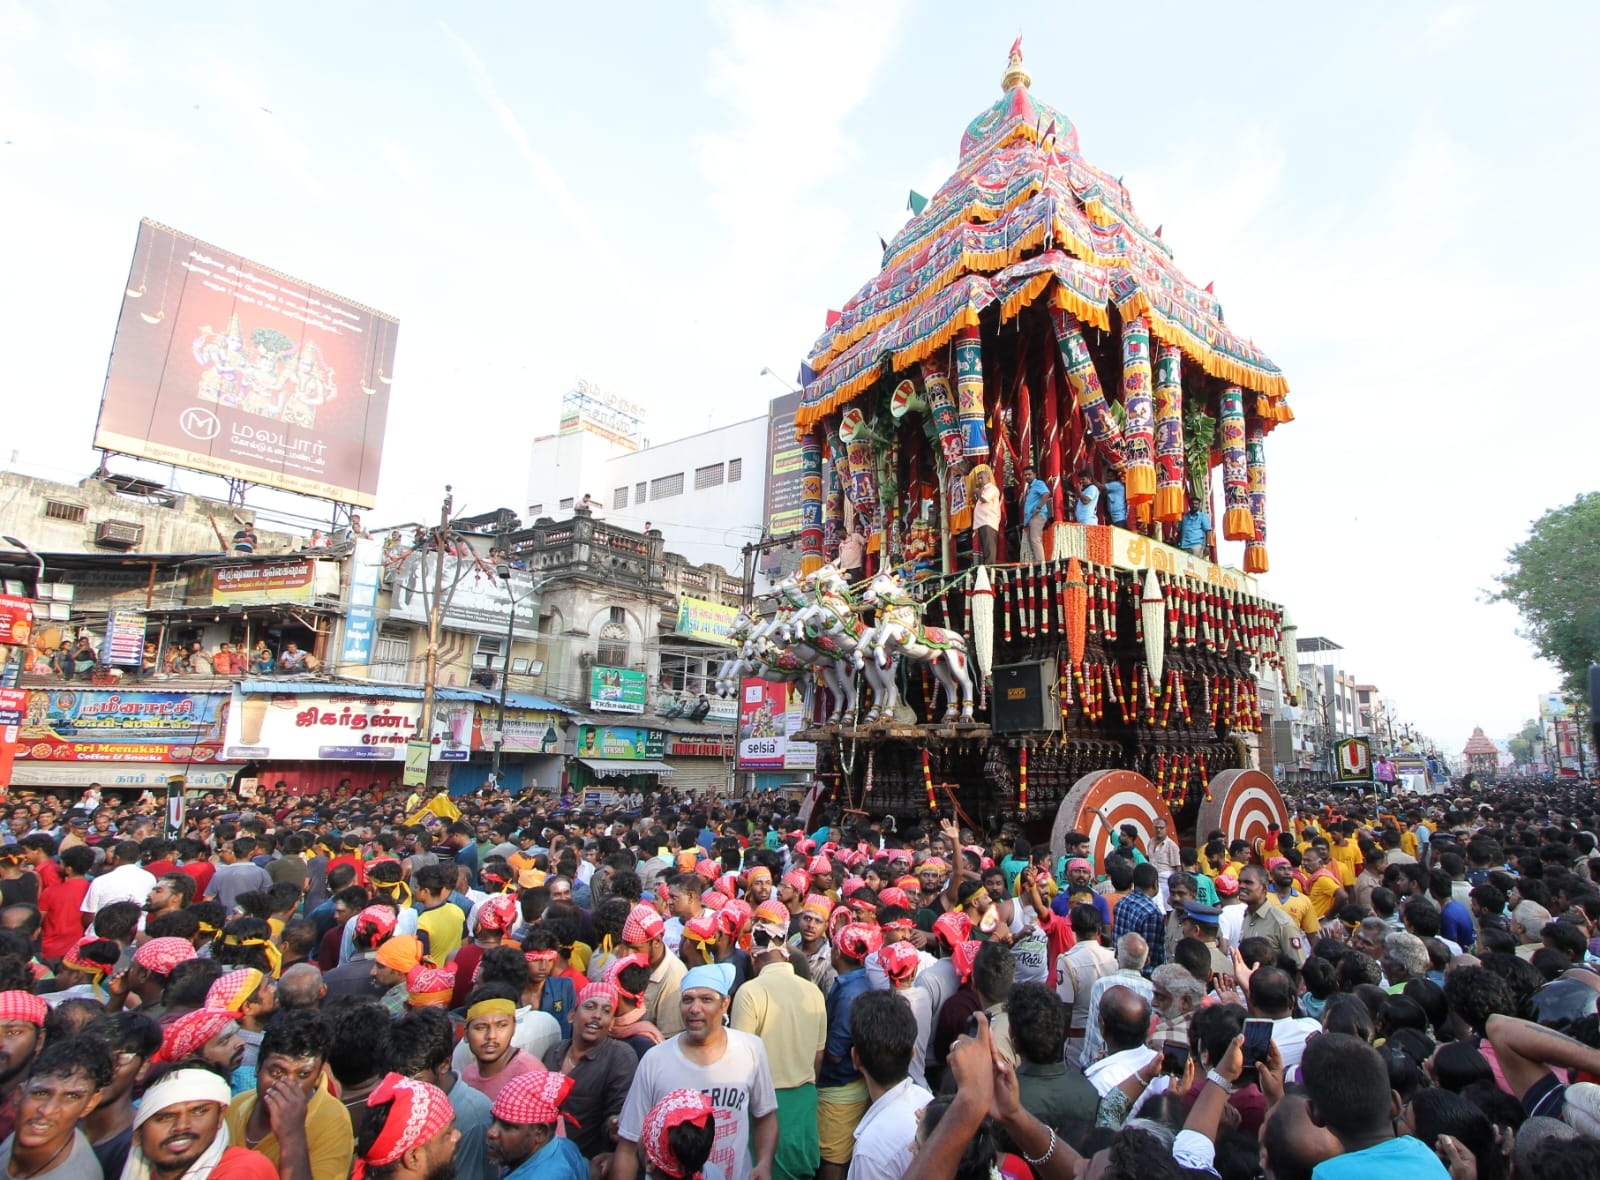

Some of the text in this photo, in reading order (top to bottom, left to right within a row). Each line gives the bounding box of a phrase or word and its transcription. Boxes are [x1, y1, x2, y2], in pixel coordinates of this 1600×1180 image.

[232, 422, 327, 455] மலபார்
[1127, 535, 1175, 575] சிவா
[99, 695, 193, 715] மீனாட்சி
[296, 706, 417, 730] ஜிகர்தண்ட
[74, 744, 168, 754] Sri Meenakshi
[748, 741, 775, 753] selsia
[77, 752, 111, 761] Coffee
[125, 753, 163, 761] Snacks
[115, 772, 145, 784] காபி
